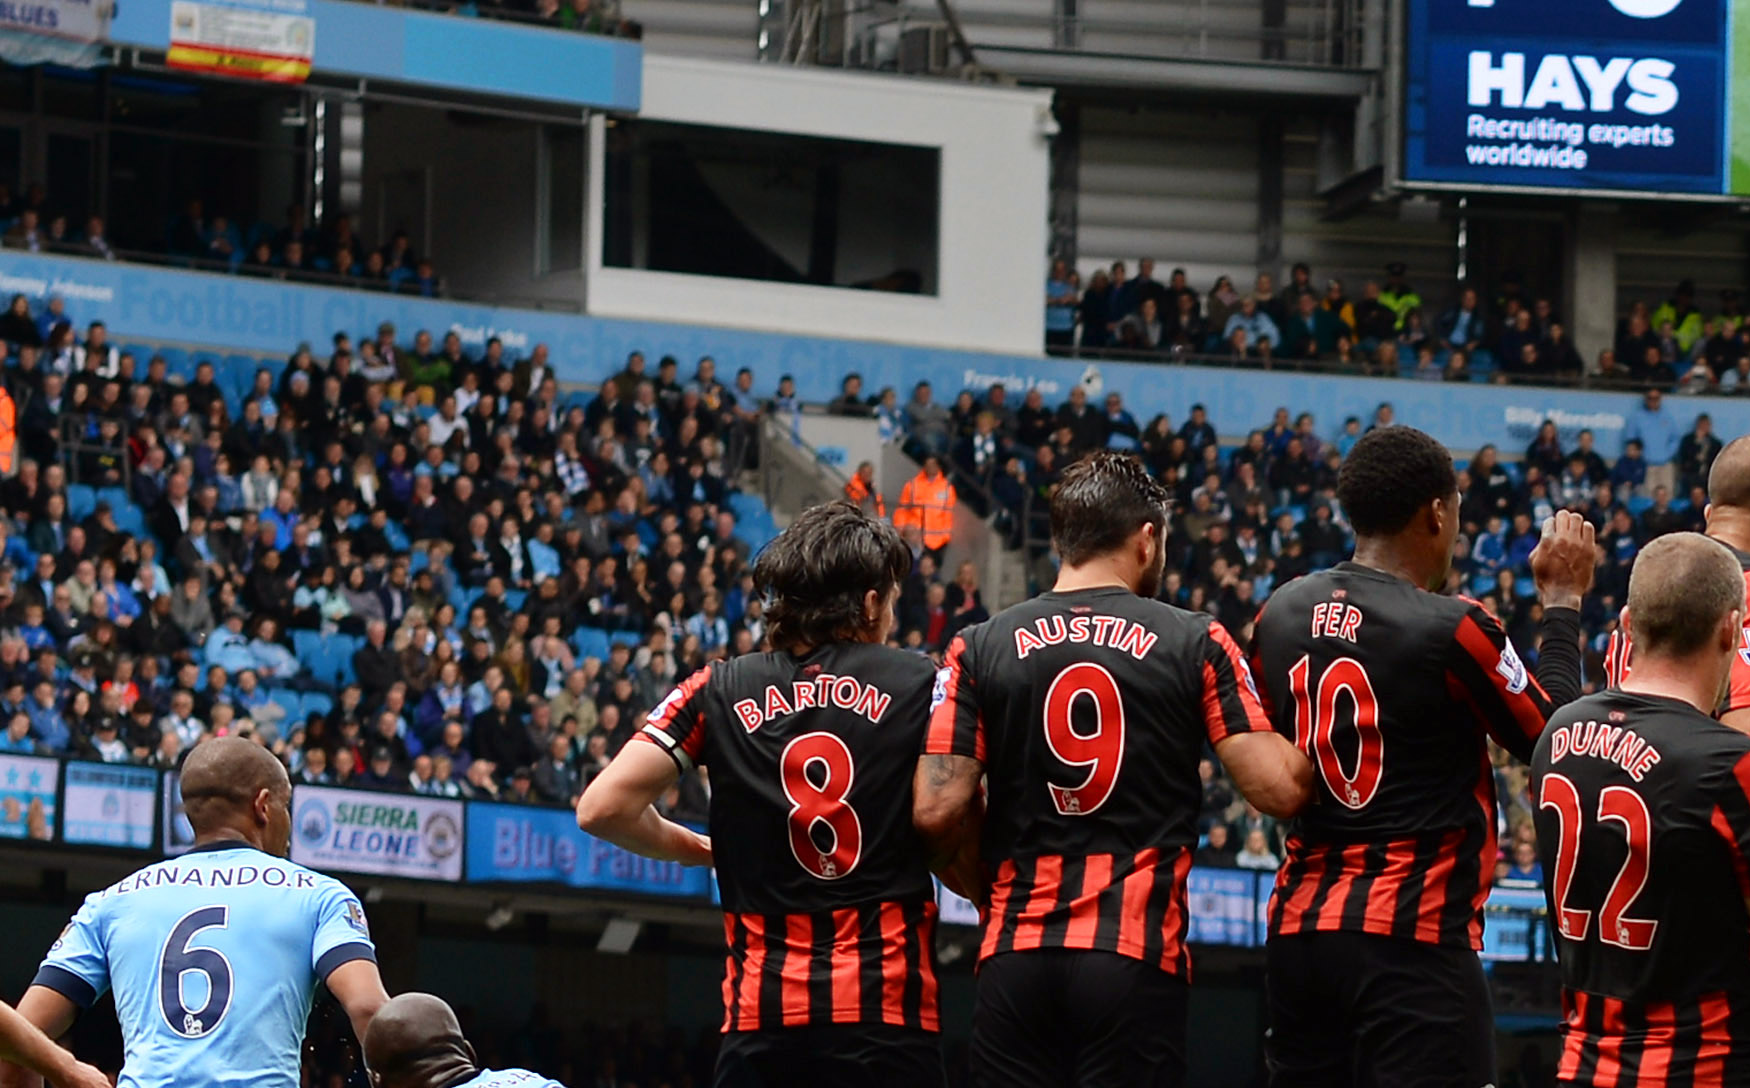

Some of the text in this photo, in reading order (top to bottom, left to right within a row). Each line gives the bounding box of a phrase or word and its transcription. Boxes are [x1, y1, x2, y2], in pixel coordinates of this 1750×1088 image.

[1467, 50, 1679, 115] HAYS
[1466, 144, 1588, 169] worldwide
[1467, 114, 1674, 147] Recruiting experts
[1014, 615, 1158, 660] AUSTIN
[1312, 602, 1363, 643] FER
[734, 674, 891, 734] BARTON
[1288, 654, 1384, 810] 10
[1043, 662, 1125, 815] 9
[1551, 721, 1661, 783] DUNNE
[335, 802, 419, 831] SIERRA
[780, 731, 862, 880] 8
[332, 829, 420, 858] LEONE
[494, 817, 578, 875] Blue
[1540, 773, 1658, 950] 22
[159, 904, 234, 1039] 6
